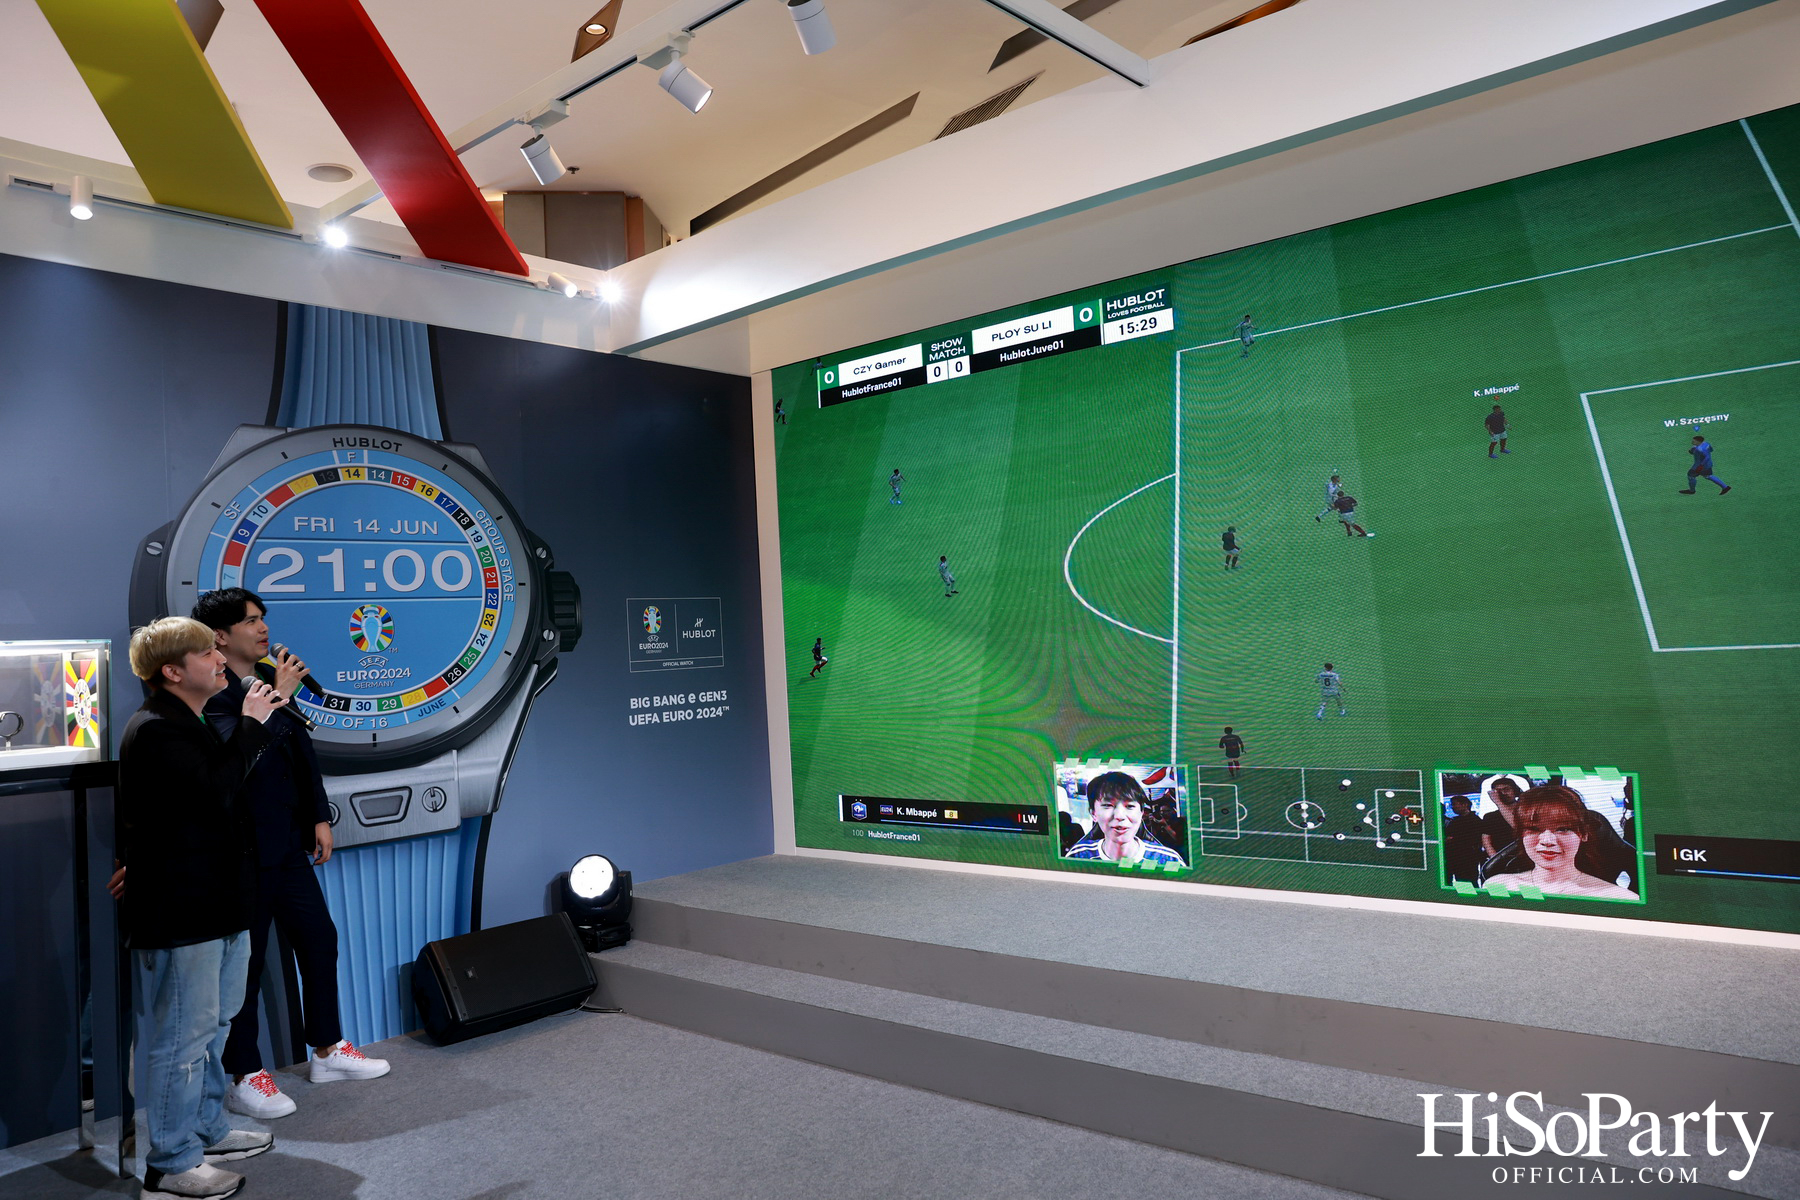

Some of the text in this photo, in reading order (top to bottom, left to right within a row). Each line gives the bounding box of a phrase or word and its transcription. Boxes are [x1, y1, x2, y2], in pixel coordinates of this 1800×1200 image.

[1107, 288, 1165, 312] HUBLOT
[1079, 307, 1093, 322] 0
[1107, 301, 1165, 319] LOVES FOOTBALL
[991, 320, 1052, 342] PLOY SU LI
[1118, 317, 1158, 336] 15:29
[930, 337, 963, 352] SHOW
[999, 340, 1065, 363] HublotJuve01
[928, 346, 966, 362] MATCH
[853, 357, 907, 376] CZY Gamer
[933, 361, 963, 378] 0 0
[824, 371, 834, 384] 0
[841, 377, 903, 399] HublotFrance01
[1473, 383, 1520, 398] K. Mbappé
[1663, 413, 1730, 428] W. Szczęsny
[332, 437, 402, 452] HUBLOT
[347, 452, 356, 462] F
[345, 468, 361, 478] 14
[371, 470, 386, 481] 14
[396, 475, 410, 486] 15
[420, 484, 434, 496] 16
[441, 497, 454, 508] 17
[223, 501, 242, 520] SF
[252, 504, 269, 519] 10
[294, 516, 439, 535] FRI 14 JUN
[456, 512, 470, 525] 18
[470, 530, 483, 543] 19
[475, 509, 514, 602] GROUP STAGE
[480, 550, 492, 563] 20
[257, 546, 473, 593] 21:00
[486, 572, 496, 584] 21
[487, 593, 497, 606] 22
[484, 613, 495, 627] 23
[476, 633, 488, 647] 24
[682, 629, 716, 639] HUBLOT
[639, 642, 669, 650] EURO2024
[360, 656, 386, 667] UEFA
[464, 651, 477, 665] 25
[337, 667, 412, 683] EURO2024
[448, 667, 462, 681] 26
[353, 680, 396, 689] GERMANY
[329, 699, 346, 710] 31
[356, 702, 372, 711] 30
[382, 699, 397, 710] 29
[630, 690, 727, 709] BIG BANG e GEN3
[418, 698, 446, 717] JUNE
[302, 707, 388, 729] UND OF 16
[629, 712, 660, 726] UEFA
[663, 709, 694, 723] EURO
[896, 807, 905, 816] K.
[905, 807, 937, 818] Mbappé
[1023, 813, 1038, 825] LW
[852, 829, 921, 842] 100 HublotFrance01
[1679, 848, 1707, 863] GK
